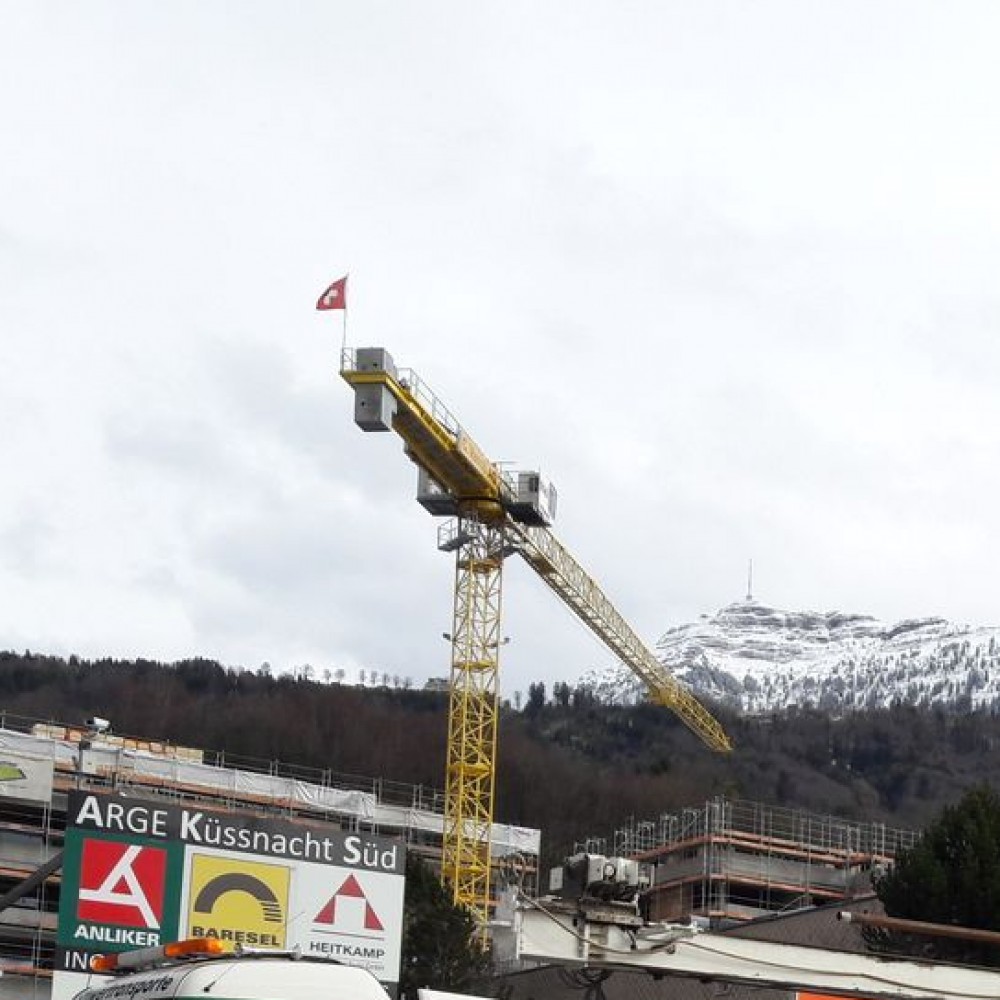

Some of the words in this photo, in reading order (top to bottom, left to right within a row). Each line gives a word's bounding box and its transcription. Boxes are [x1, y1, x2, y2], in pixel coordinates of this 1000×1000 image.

[75, 795, 168, 837] ARGE
[180, 810, 334, 861] Küssnacht
[343, 836, 398, 869] Süd
[74, 924, 160, 946] ANLIKER
[192, 926, 280, 945] BARESEL
[309, 941, 386, 959] HEITKAMP
